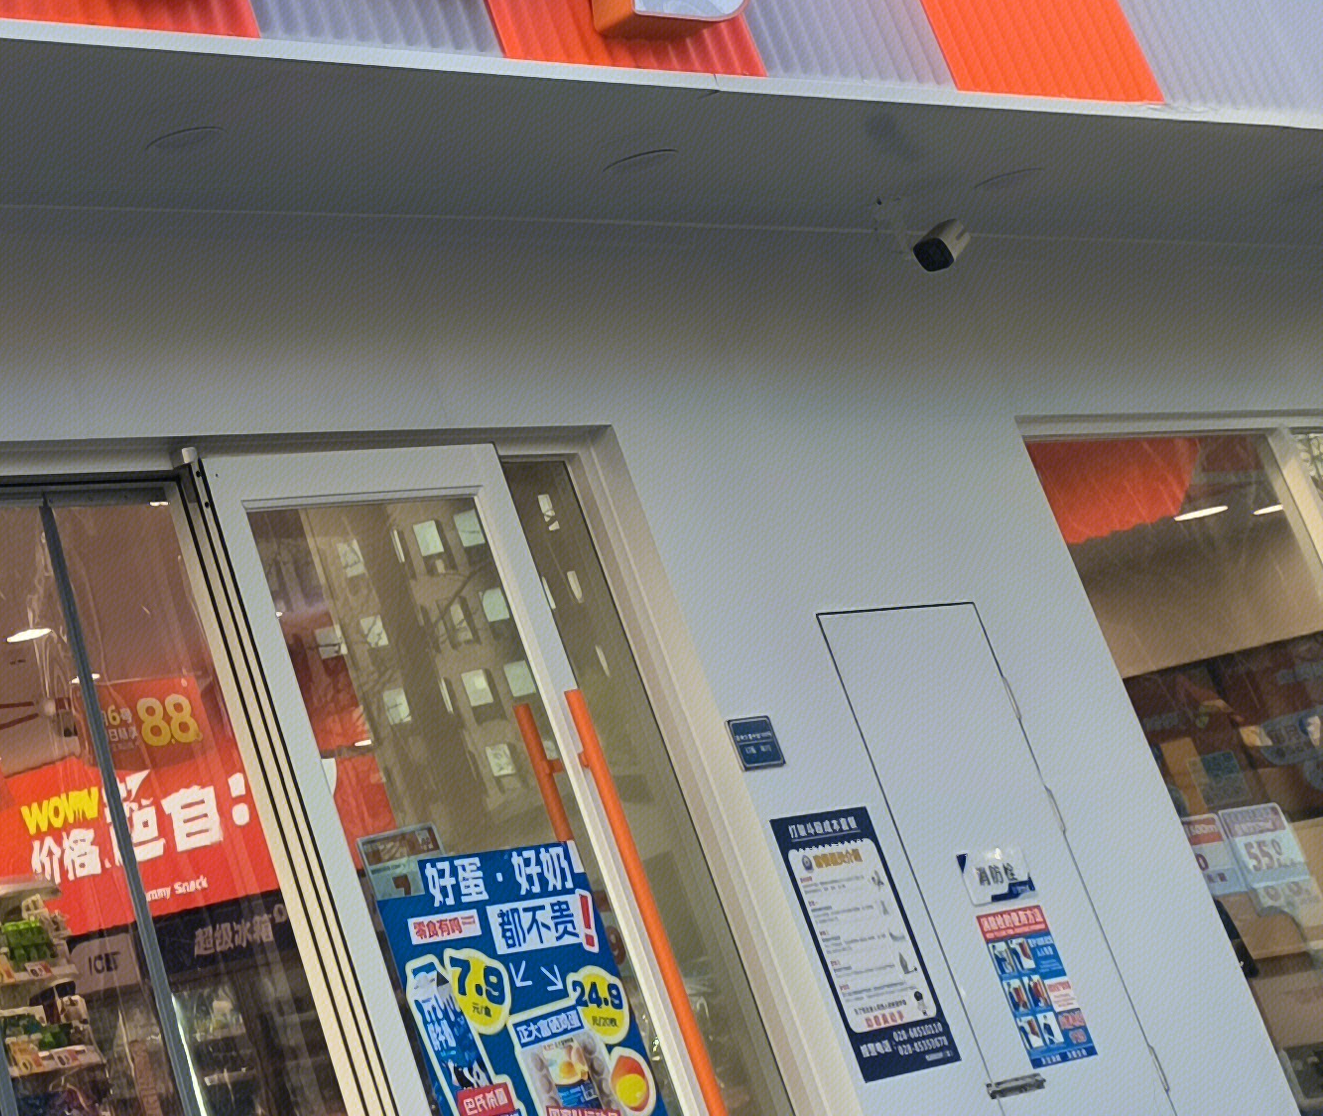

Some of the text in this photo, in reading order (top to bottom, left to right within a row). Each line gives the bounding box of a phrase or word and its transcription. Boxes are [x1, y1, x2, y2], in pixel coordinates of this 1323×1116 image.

[174, 874, 209, 896] Snack
[449, 956, 505, 1006] 7.9
[571, 980, 624, 1011] 24.9
